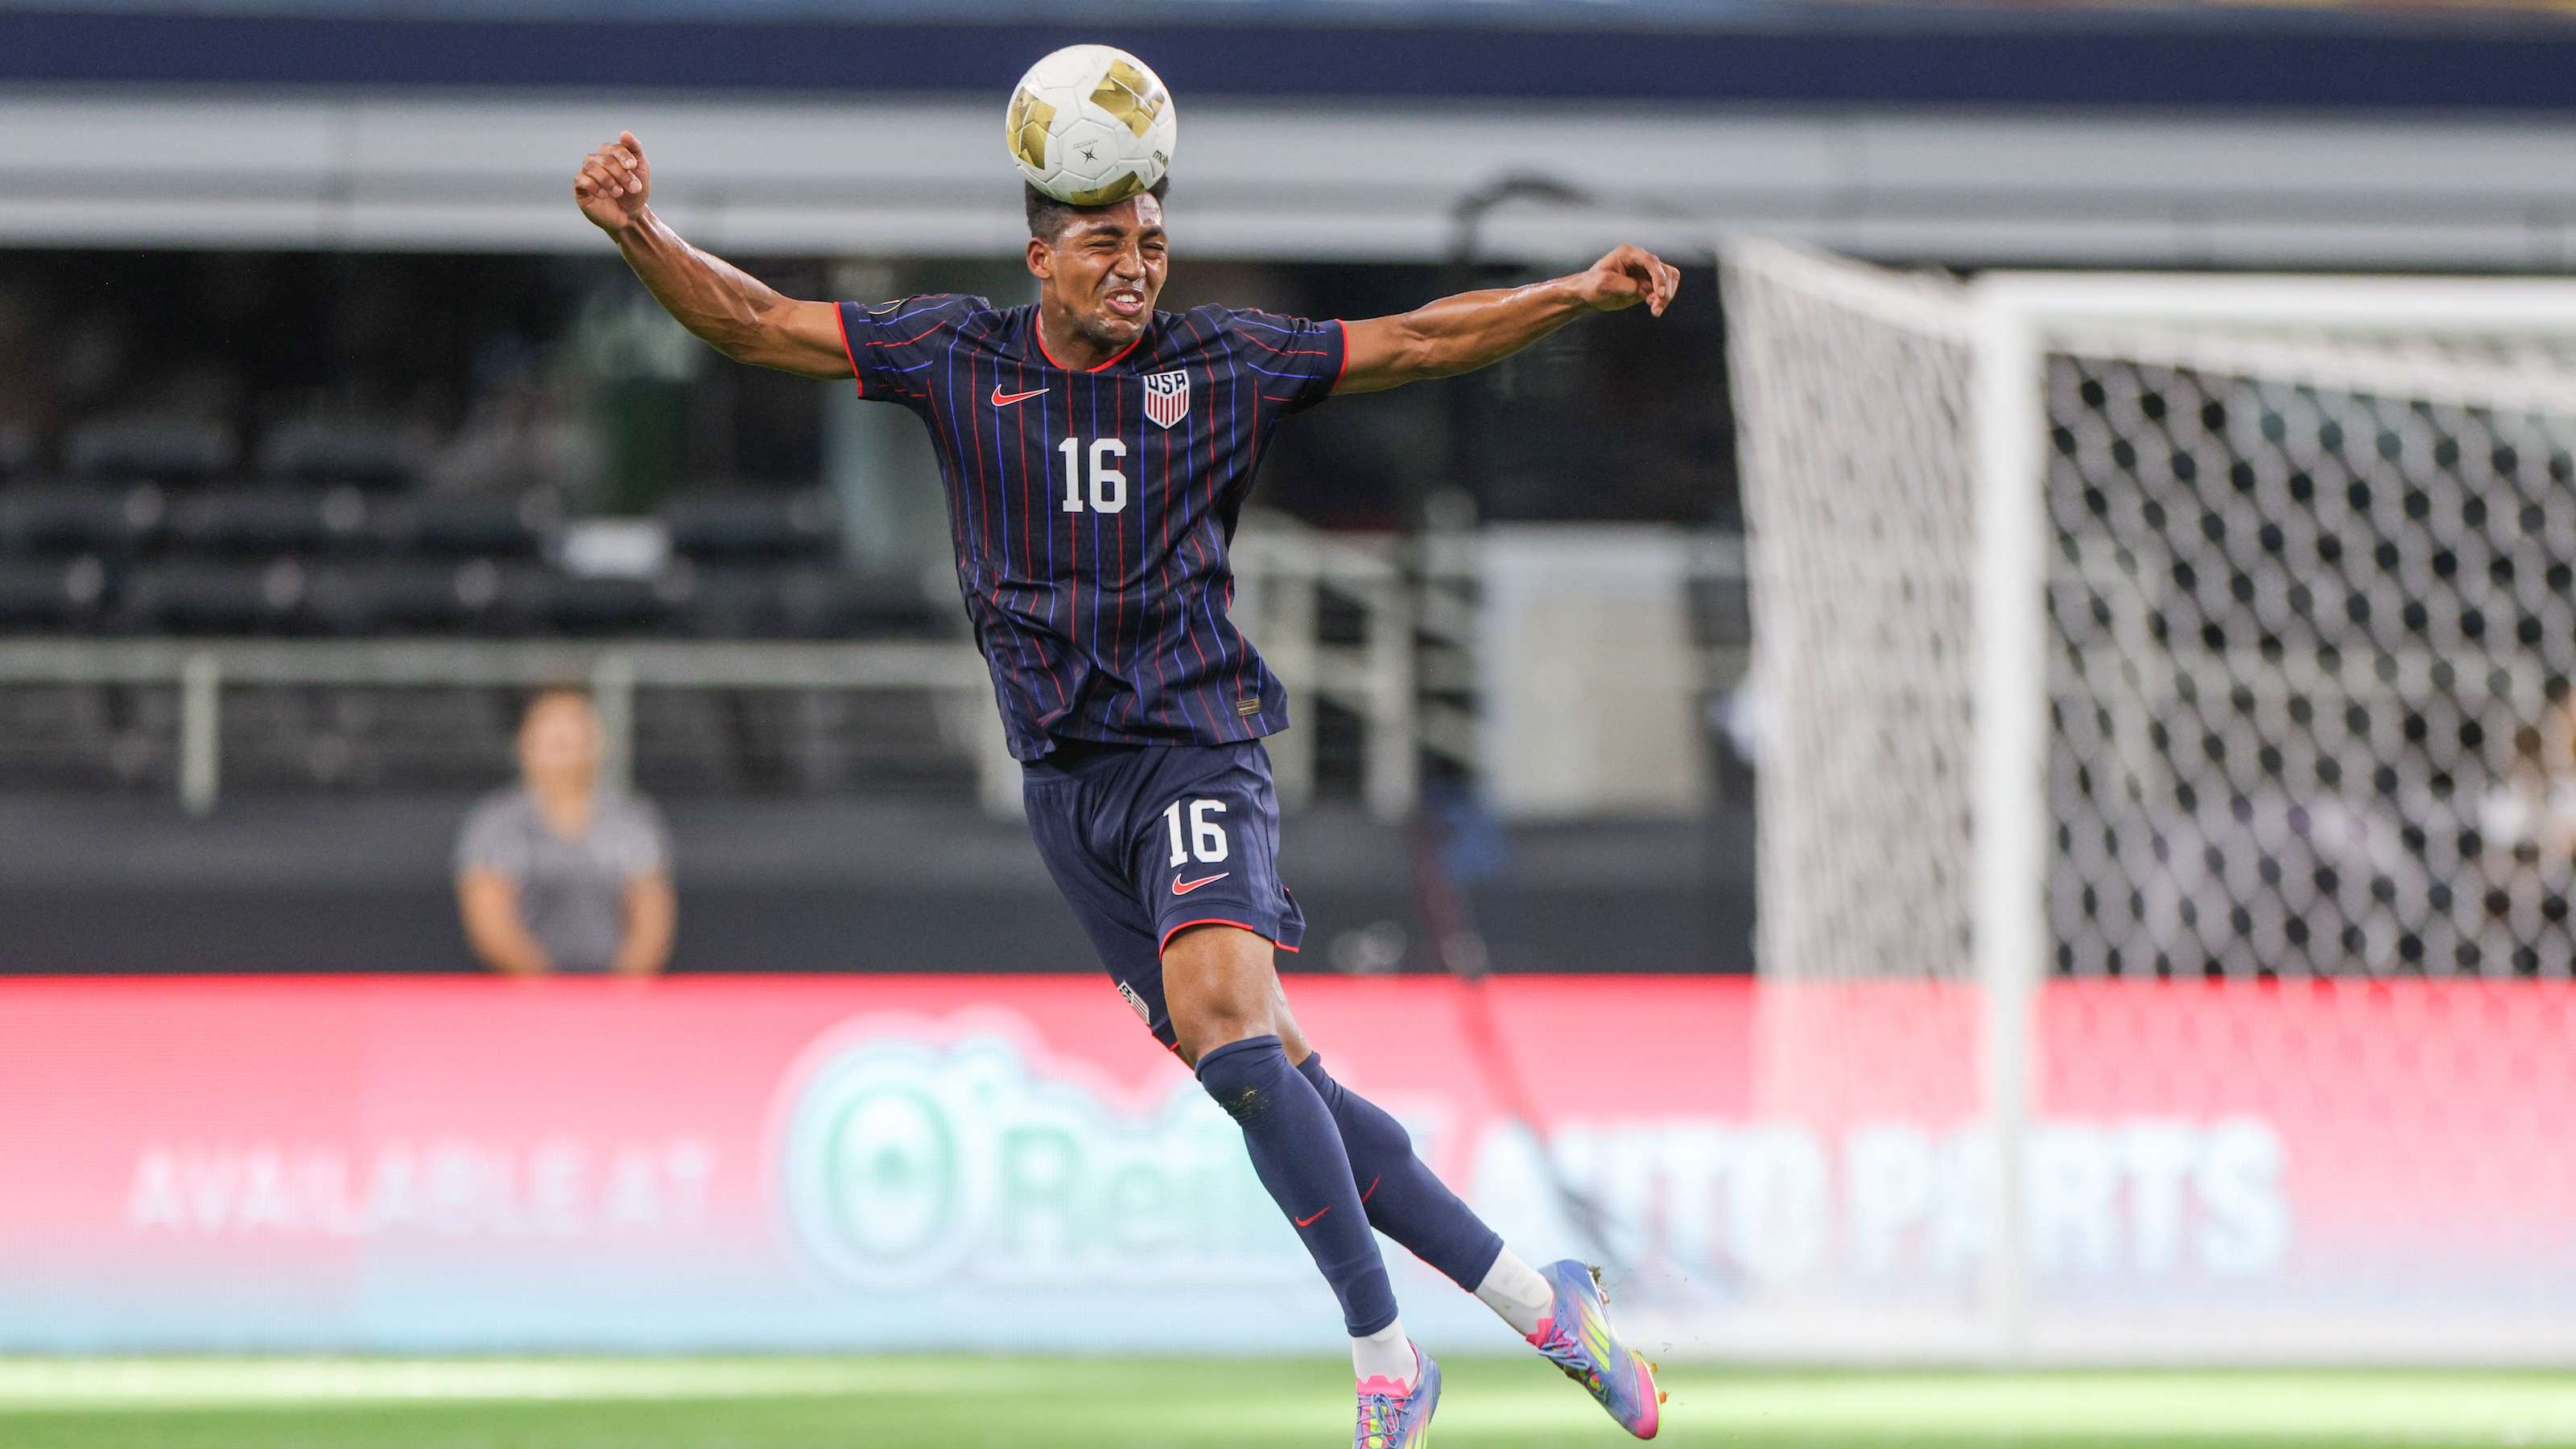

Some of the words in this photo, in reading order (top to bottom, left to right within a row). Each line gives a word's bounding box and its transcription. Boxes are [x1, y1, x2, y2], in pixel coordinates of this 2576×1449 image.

[1147, 373, 1186, 394] USA
[1059, 437, 1127, 514] 16
[1162, 799, 1228, 868] 16
